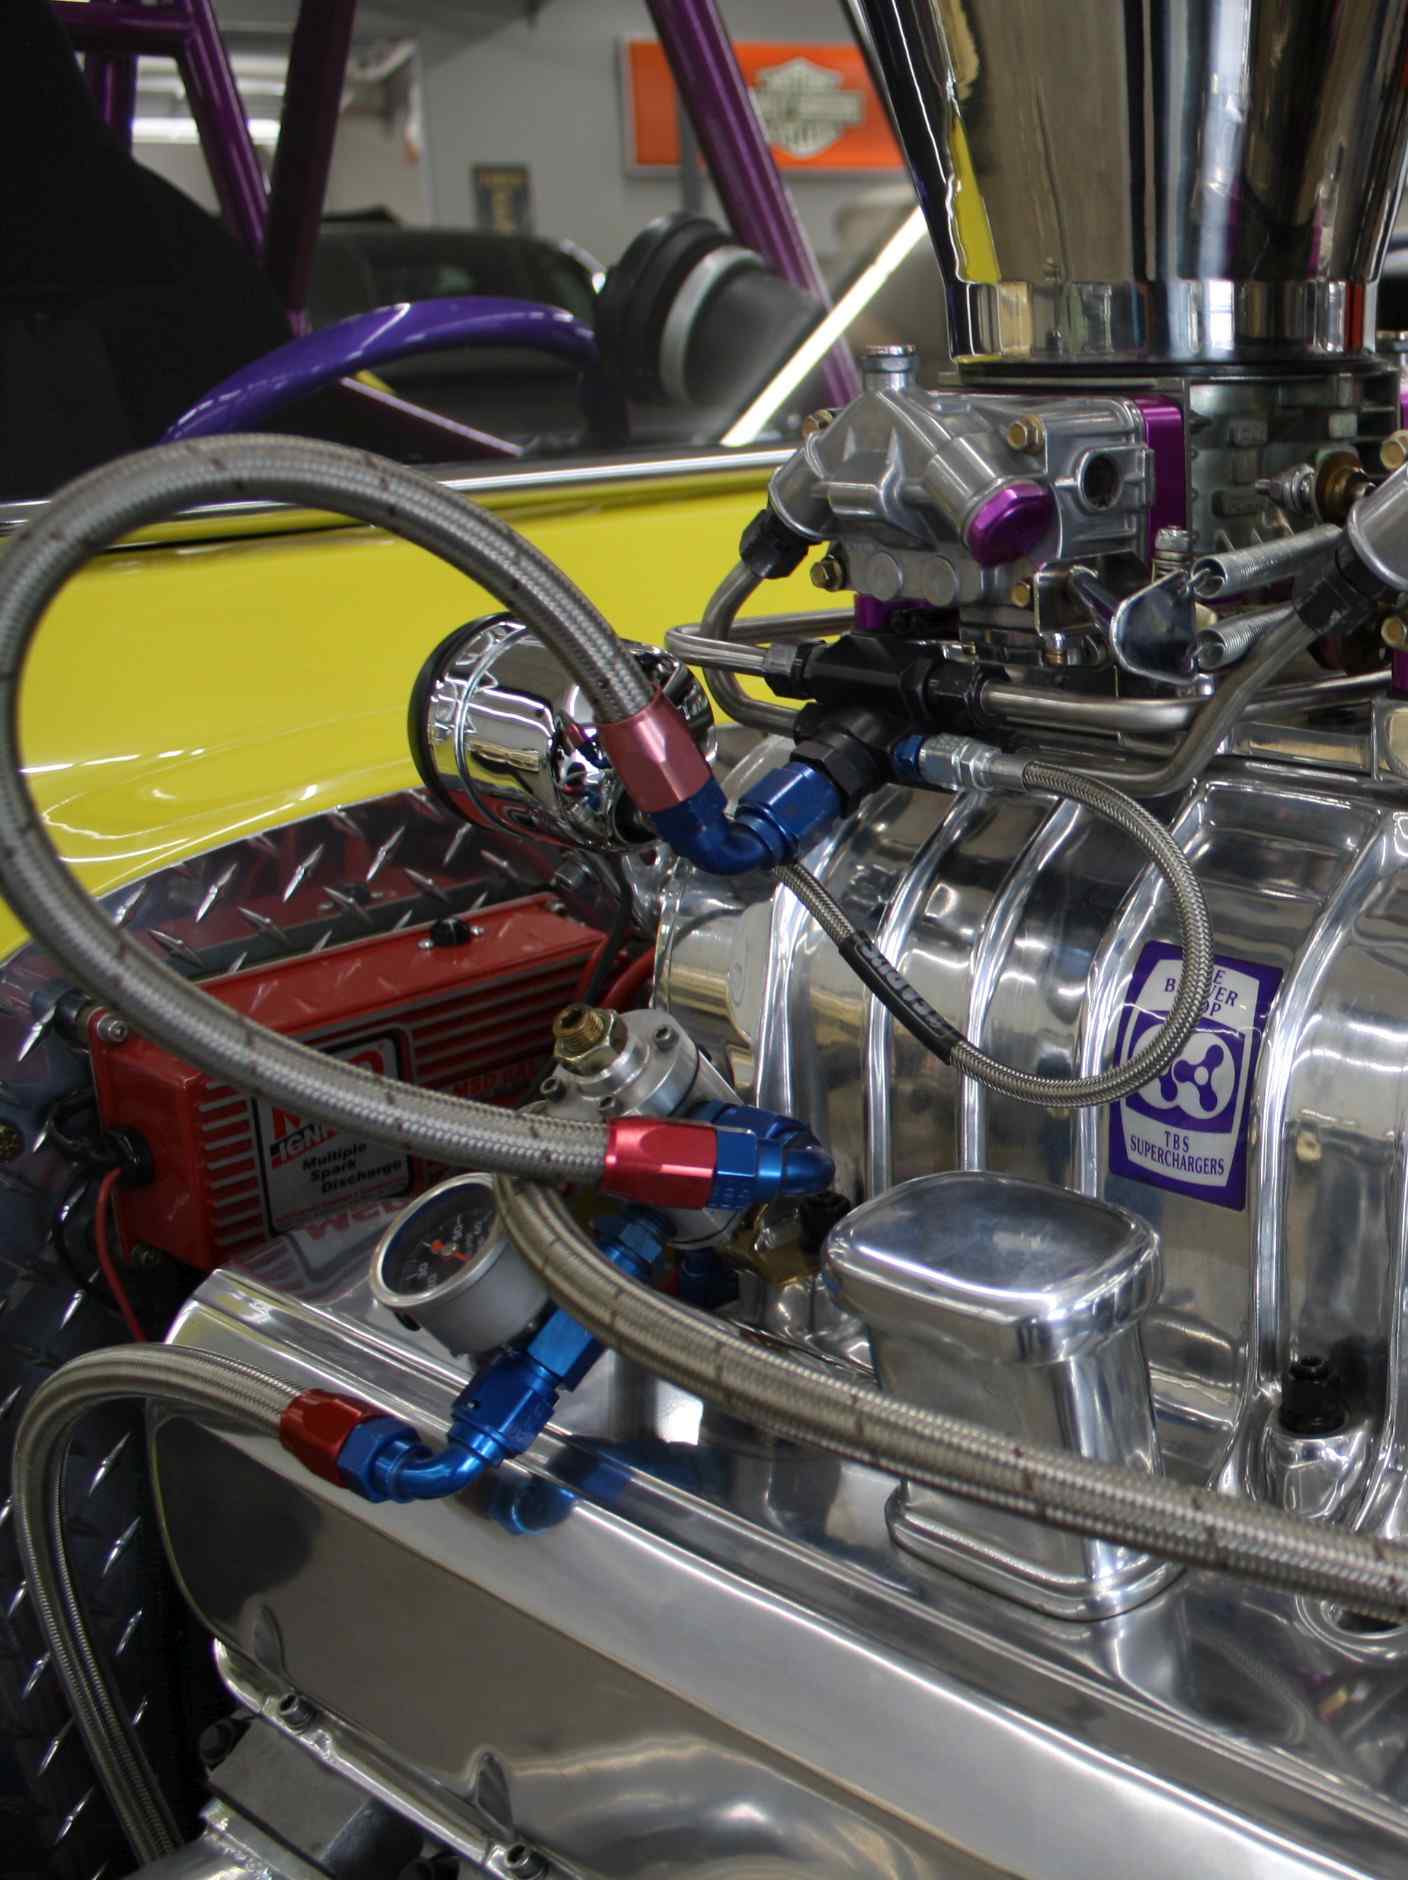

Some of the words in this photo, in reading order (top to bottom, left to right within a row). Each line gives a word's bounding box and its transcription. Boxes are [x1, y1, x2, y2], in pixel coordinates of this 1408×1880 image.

[1129, 1133, 1225, 1177] SUPERCHARGERS
[1164, 1130, 1190, 1153] TBS
[303, 1143, 368, 1170] Multiple
[311, 1159, 357, 1181] Spark
[321, 1160, 403, 1193] Discharge
